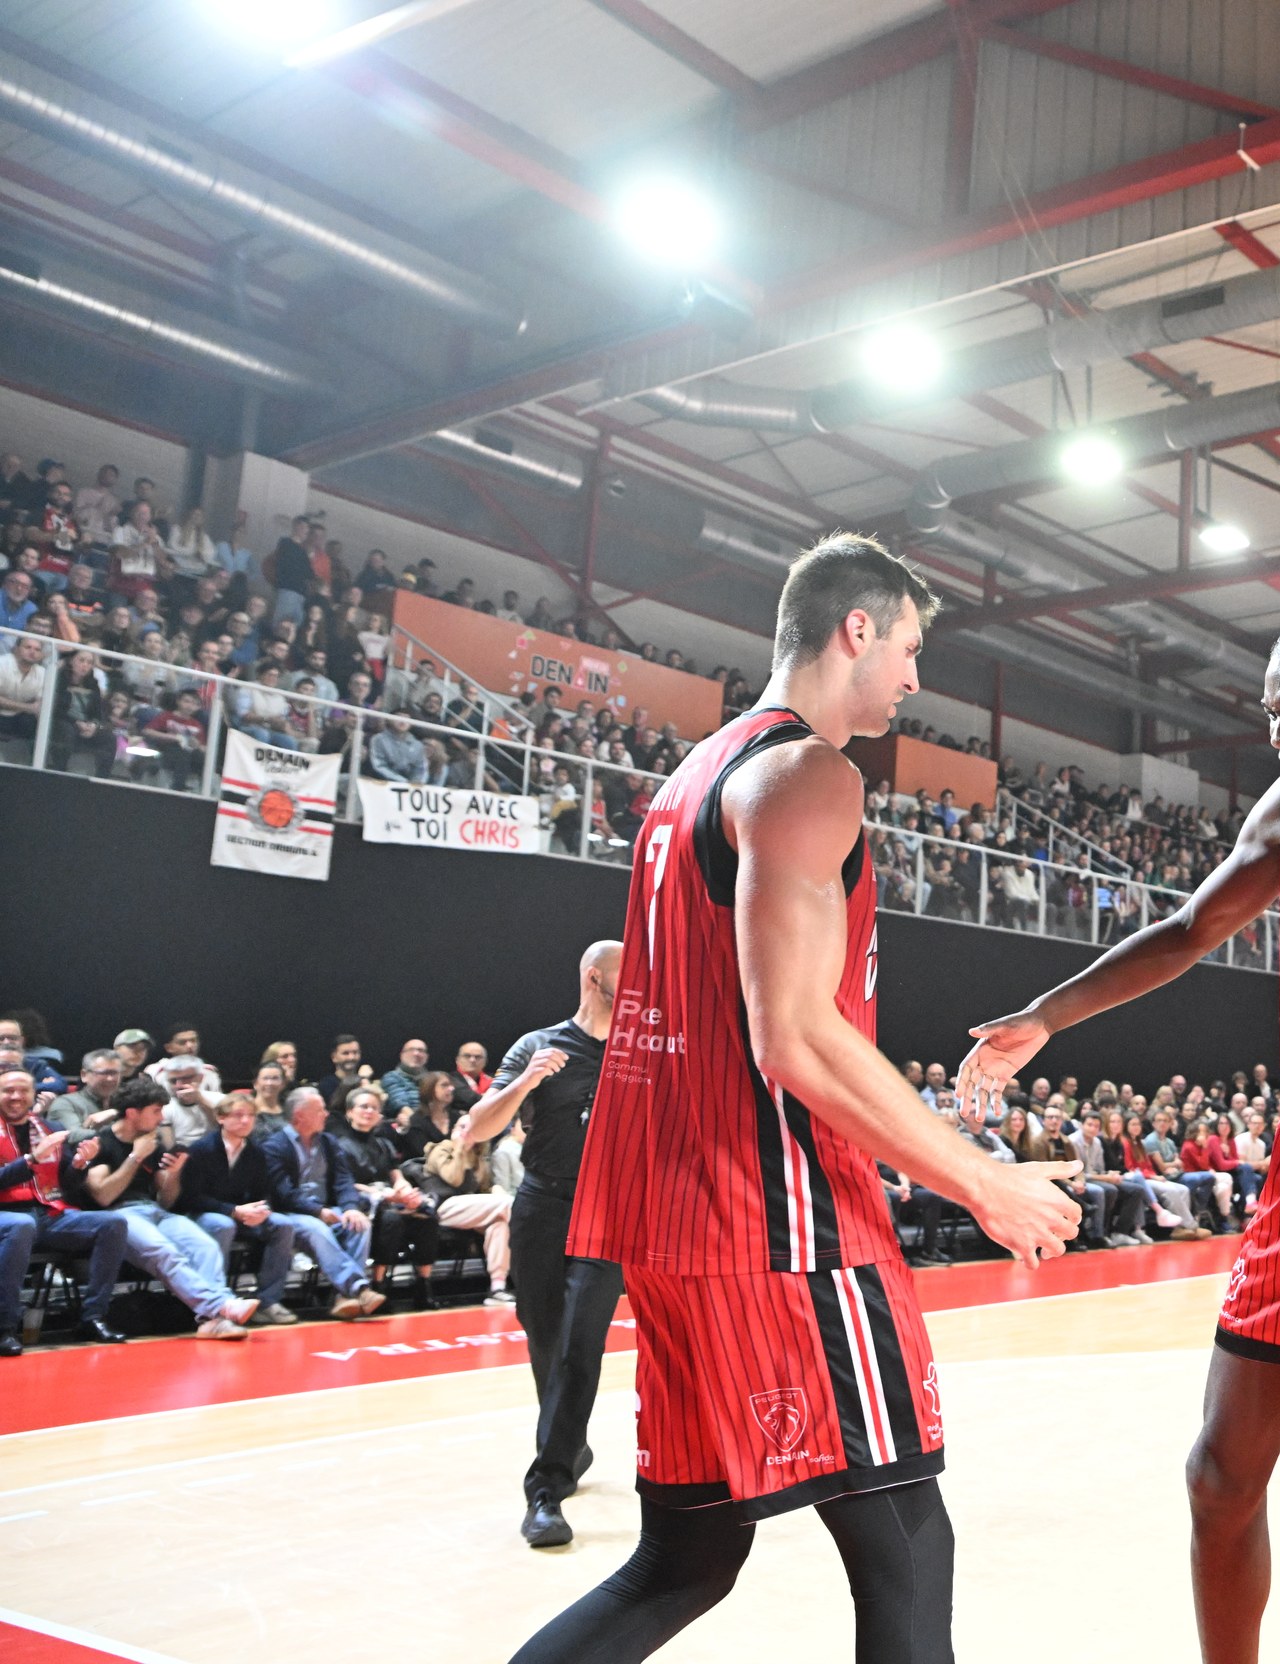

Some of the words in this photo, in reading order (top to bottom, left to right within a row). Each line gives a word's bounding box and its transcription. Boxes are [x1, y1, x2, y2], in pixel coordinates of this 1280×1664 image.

[390, 788, 452, 815] TOUS
[466, 796, 518, 820] AVEC
[410, 818, 447, 841] TOI
[459, 819, 520, 849] CHRIS
[608, 1061, 649, 1074] Commu
[766, 1449, 809, 1466] DENAIN
